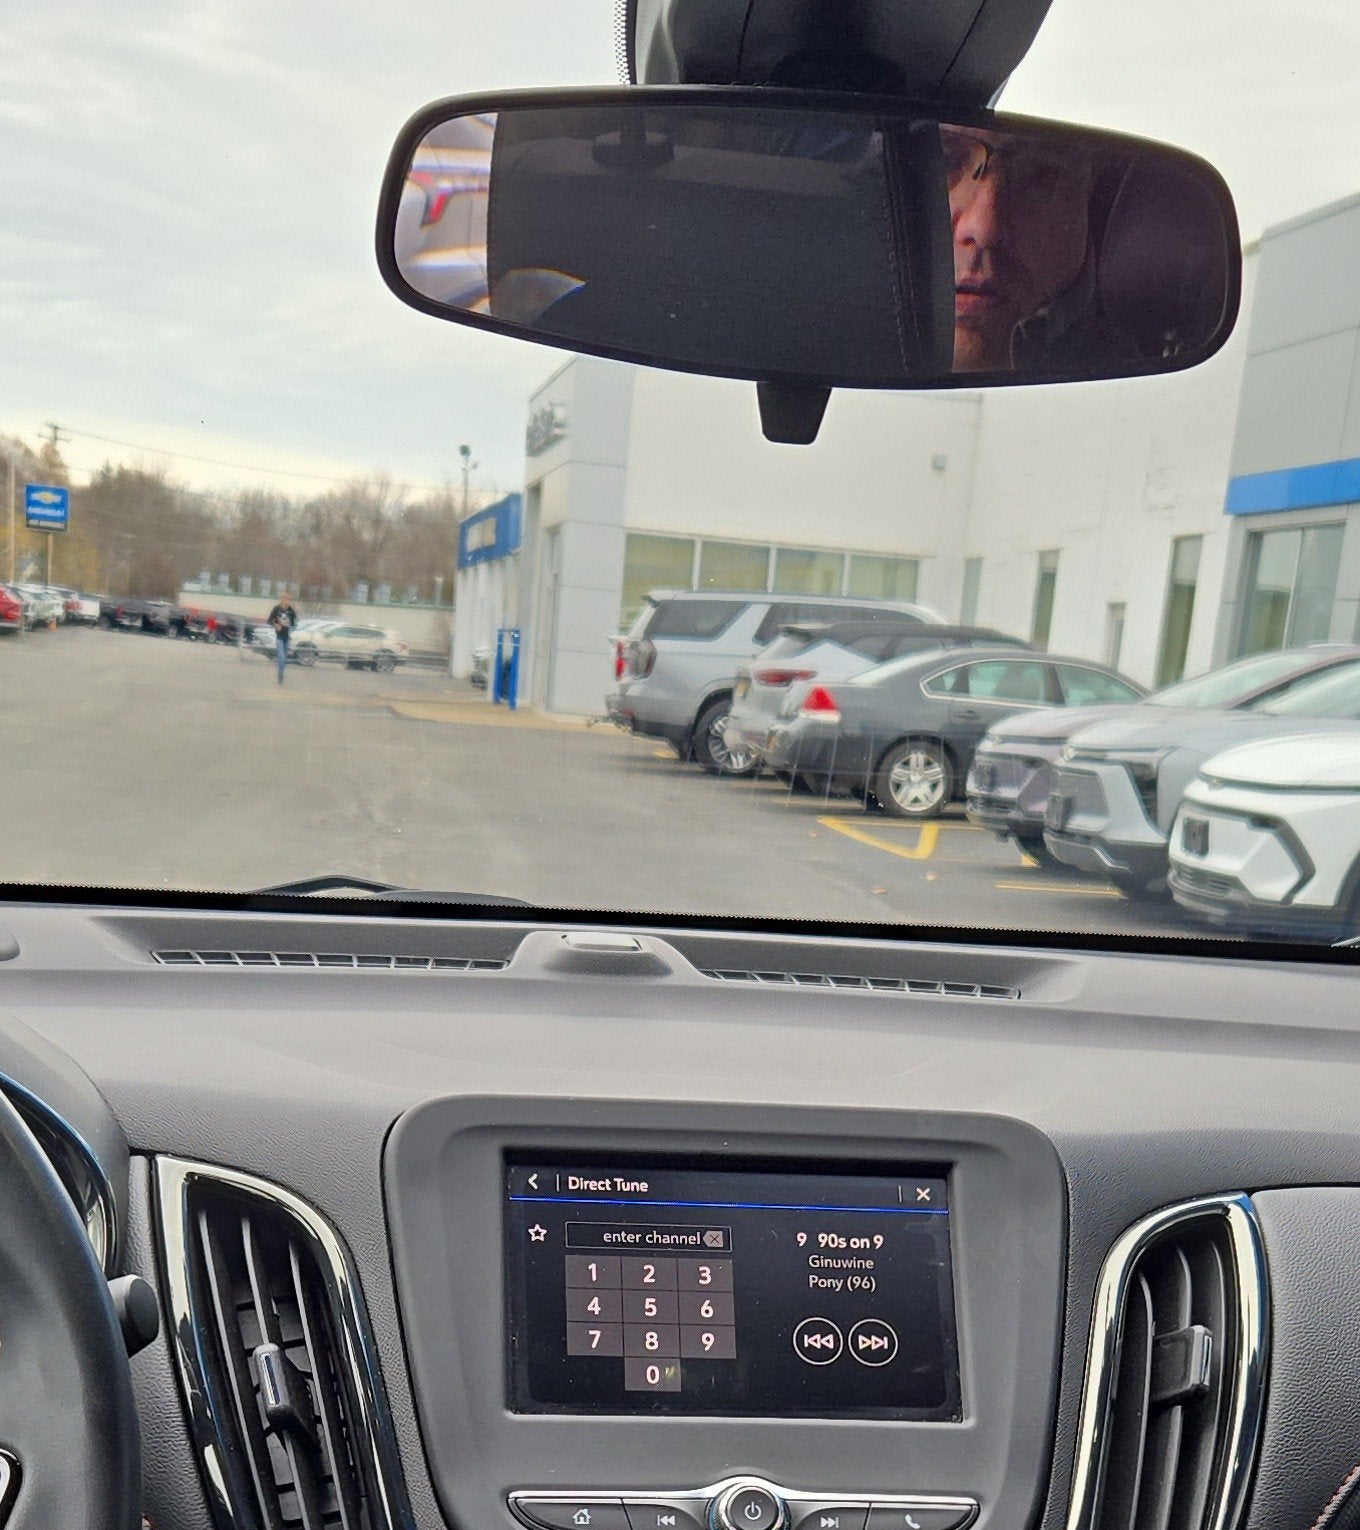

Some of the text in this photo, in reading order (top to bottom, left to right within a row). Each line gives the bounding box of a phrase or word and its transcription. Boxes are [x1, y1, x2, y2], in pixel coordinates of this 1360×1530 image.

[568, 1176, 649, 1192] Direct Tune
[603, 1230, 701, 1245] enter channel
[797, 1232, 884, 1249] 9 90s on 9
[808, 1254, 875, 1269] Ginuwine
[588, 1263, 712, 1285] 1 2 3
[808, 1274, 876, 1292] Pony (96)
[587, 1296, 713, 1318] 4 5 6
[588, 1330, 715, 1351] 7 8 9
[646, 1365, 660, 1384] 0
